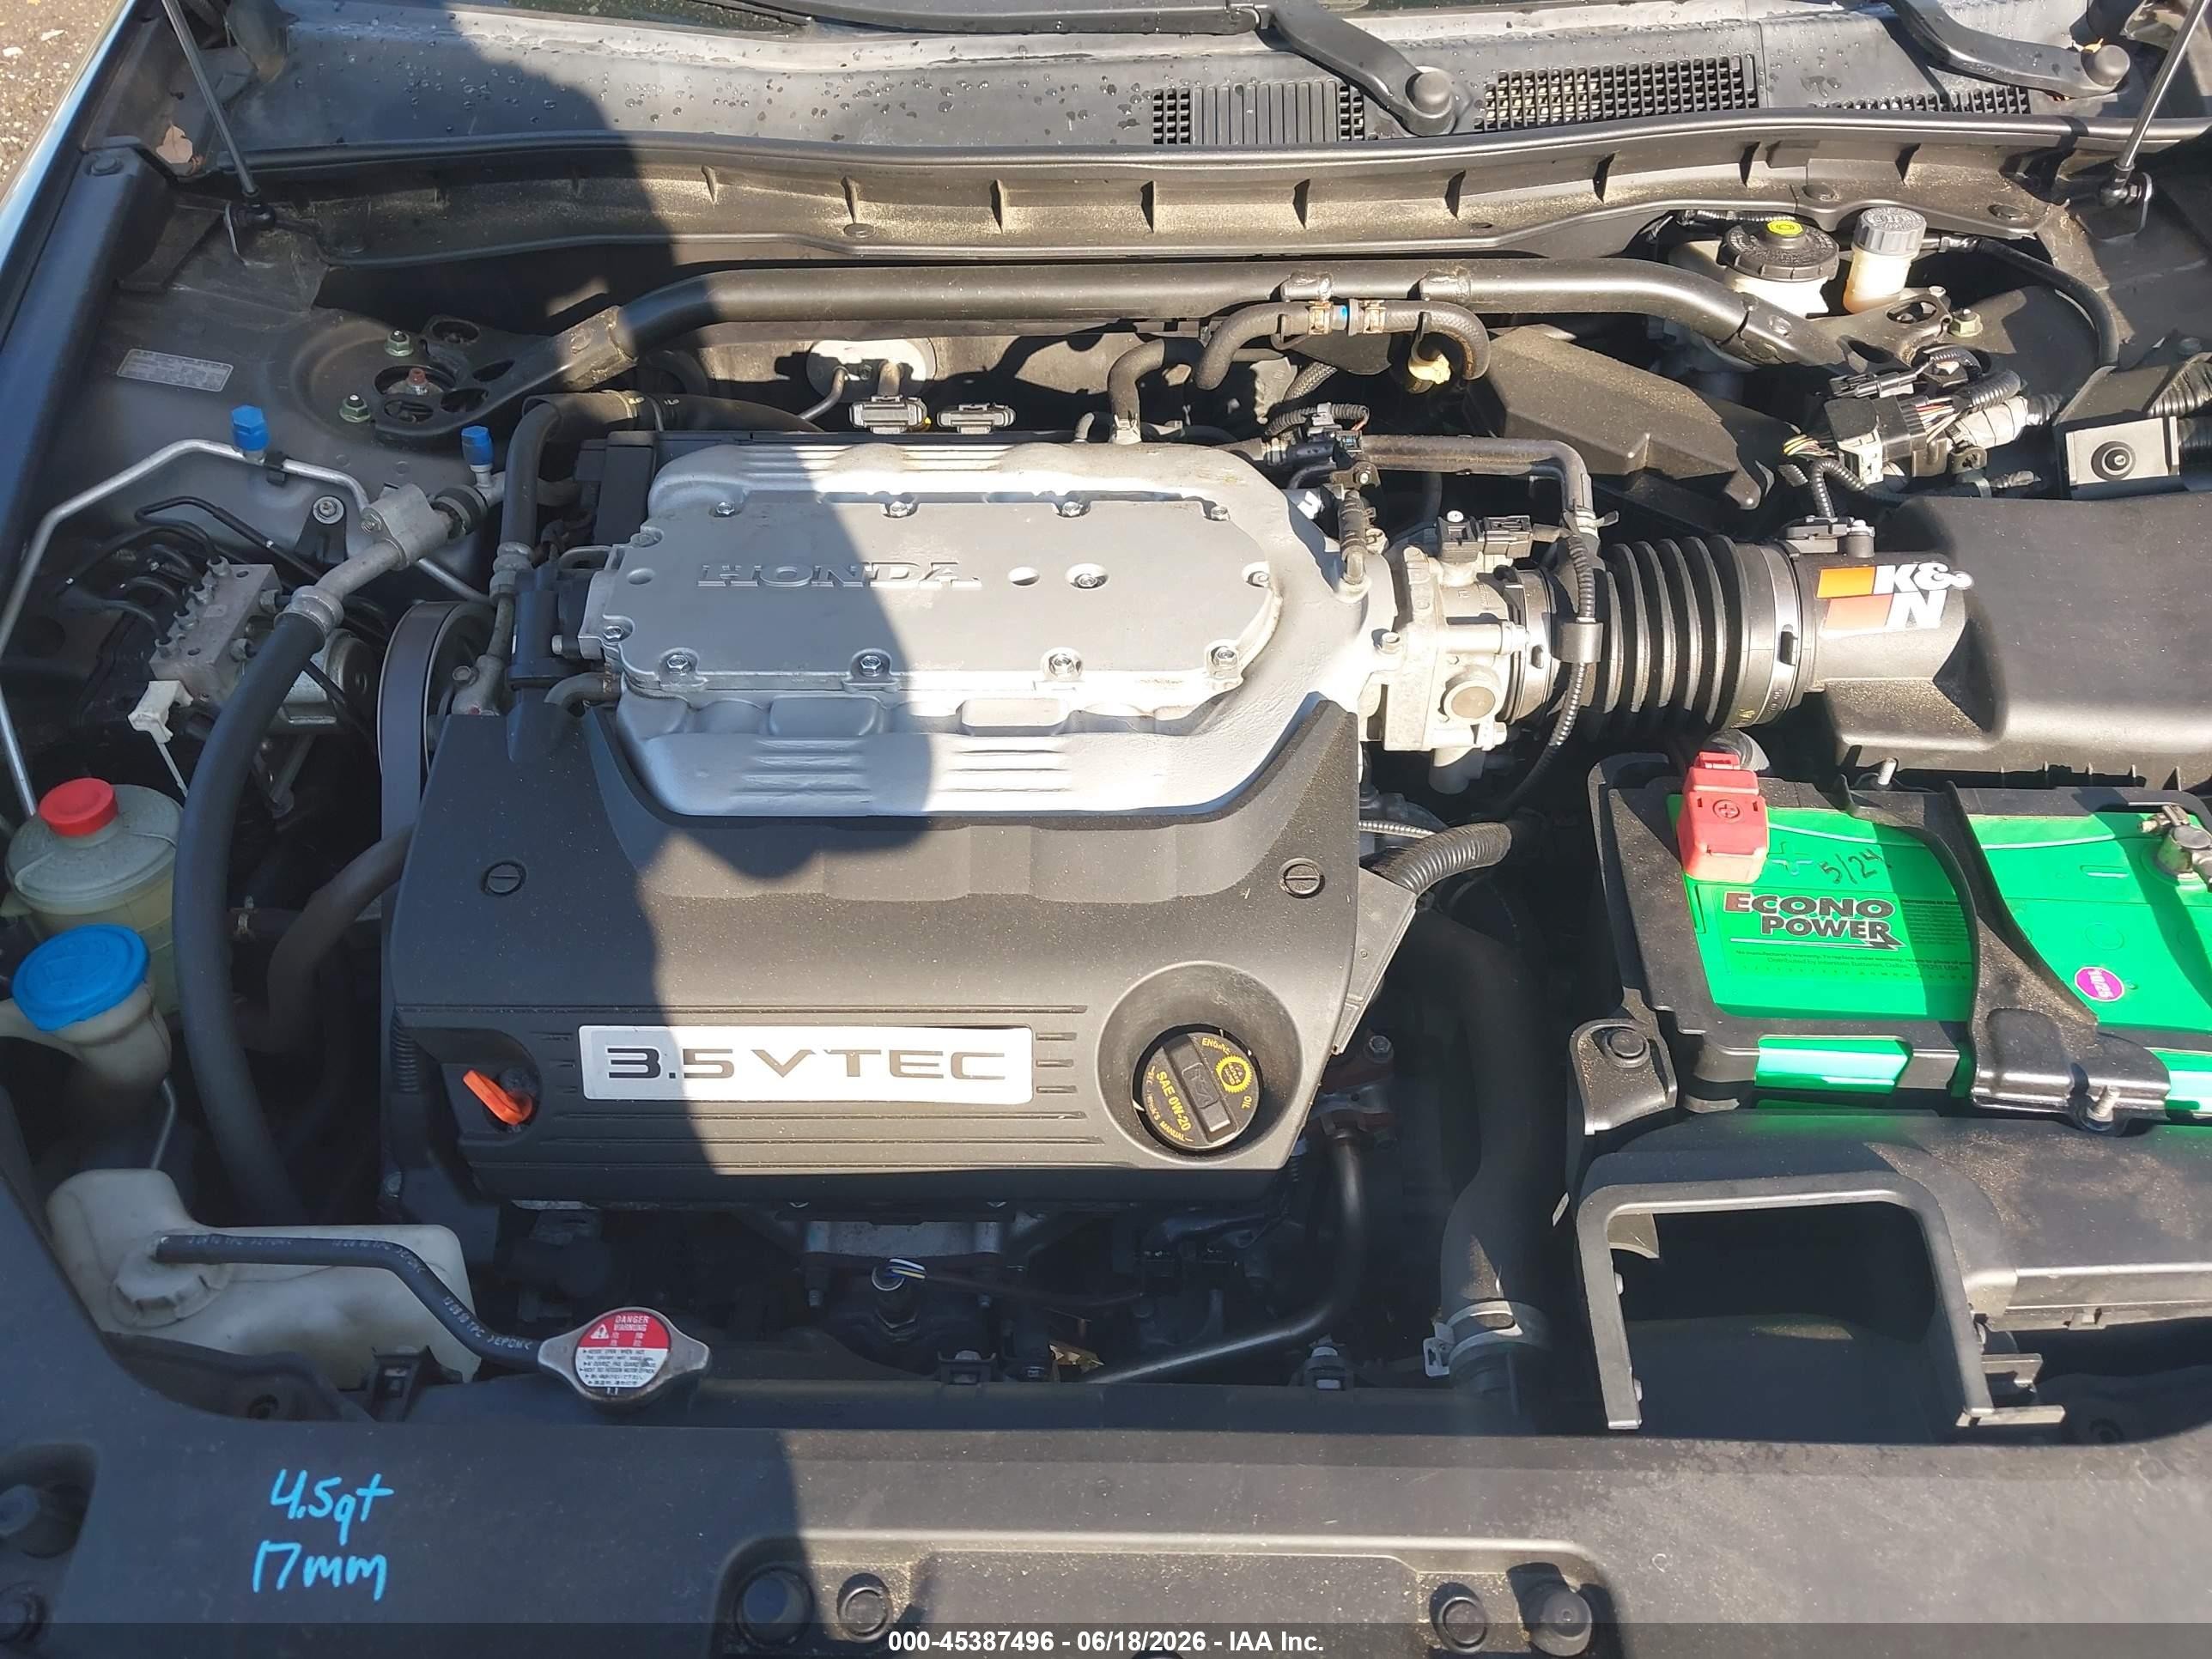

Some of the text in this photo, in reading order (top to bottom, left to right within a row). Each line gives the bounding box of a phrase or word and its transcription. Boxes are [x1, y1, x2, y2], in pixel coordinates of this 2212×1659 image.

[697, 562, 982, 587] HONDA
[1724, 890, 1894, 919] ECONO
[1760, 915, 1895, 941] POWER
[606, 1047, 1006, 1080] 3.5 VTEC
[1156, 1071, 1192, 1132] SAE 0W-20
[1241, 1095, 1253, 1110] OIL
[615, 1315, 651, 1324] DANGER
[252, 1539, 388, 1601] 17mm
